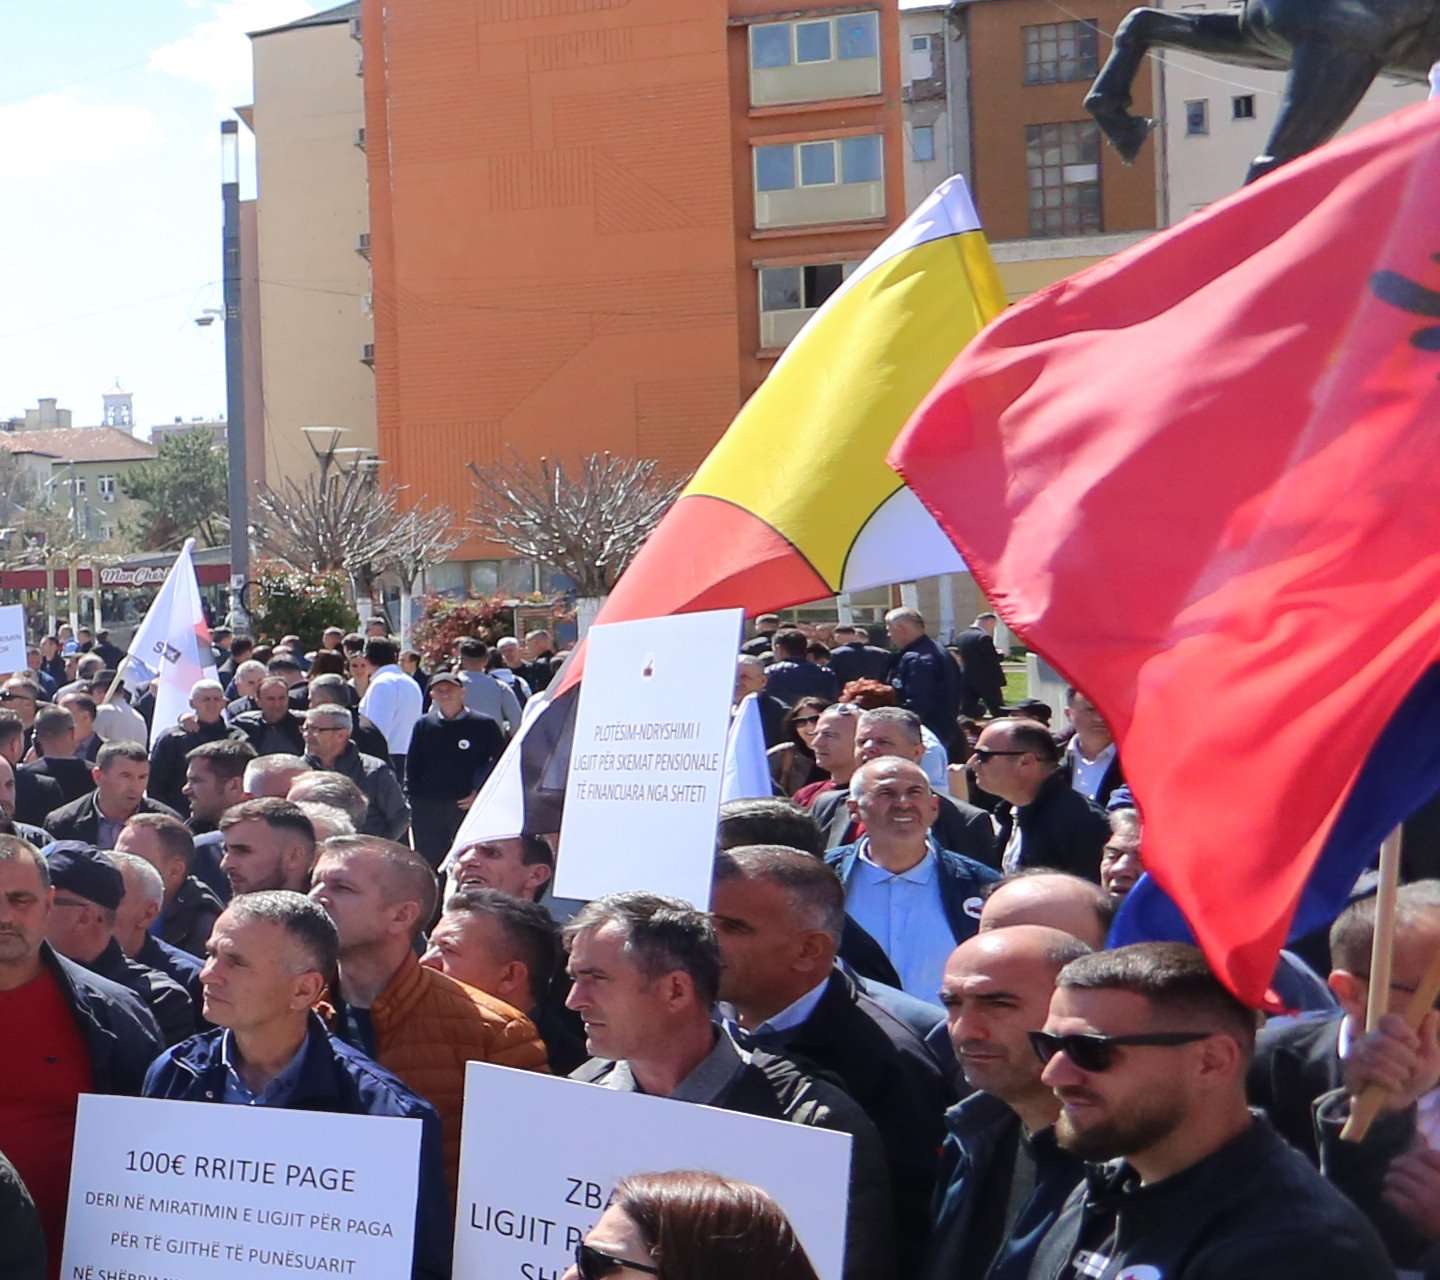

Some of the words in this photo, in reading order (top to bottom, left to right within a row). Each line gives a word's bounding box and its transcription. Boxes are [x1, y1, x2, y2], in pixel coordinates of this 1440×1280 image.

[617, 753, 655, 771] SKEMAT
[655, 753, 719, 772] PENSIONALE
[646, 785, 669, 802] NGA
[670, 785, 707, 802] SHTETI
[125, 1149, 186, 1176] 100€
[194, 1156, 277, 1185] RRITJE
[285, 1165, 356, 1193] PAGE
[85, 1191, 120, 1208] DERI
[124, 1192, 145, 1211] NË
[149, 1198, 238, 1221] MIRATIMIN
[243, 1207, 253, 1222] E
[256, 1209, 305, 1229] LIGJIT
[310, 1211, 341, 1233] PËR
[346, 1218, 394, 1238] PAGA
[470, 1202, 557, 1246] LIGJIT
[111, 1230, 139, 1249] PËR
[144, 1233, 162, 1252] TË
[166, 1239, 220, 1260] GJITHË
[226, 1242, 244, 1262] TË
[248, 1248, 356, 1275] PUNËSUARIT
